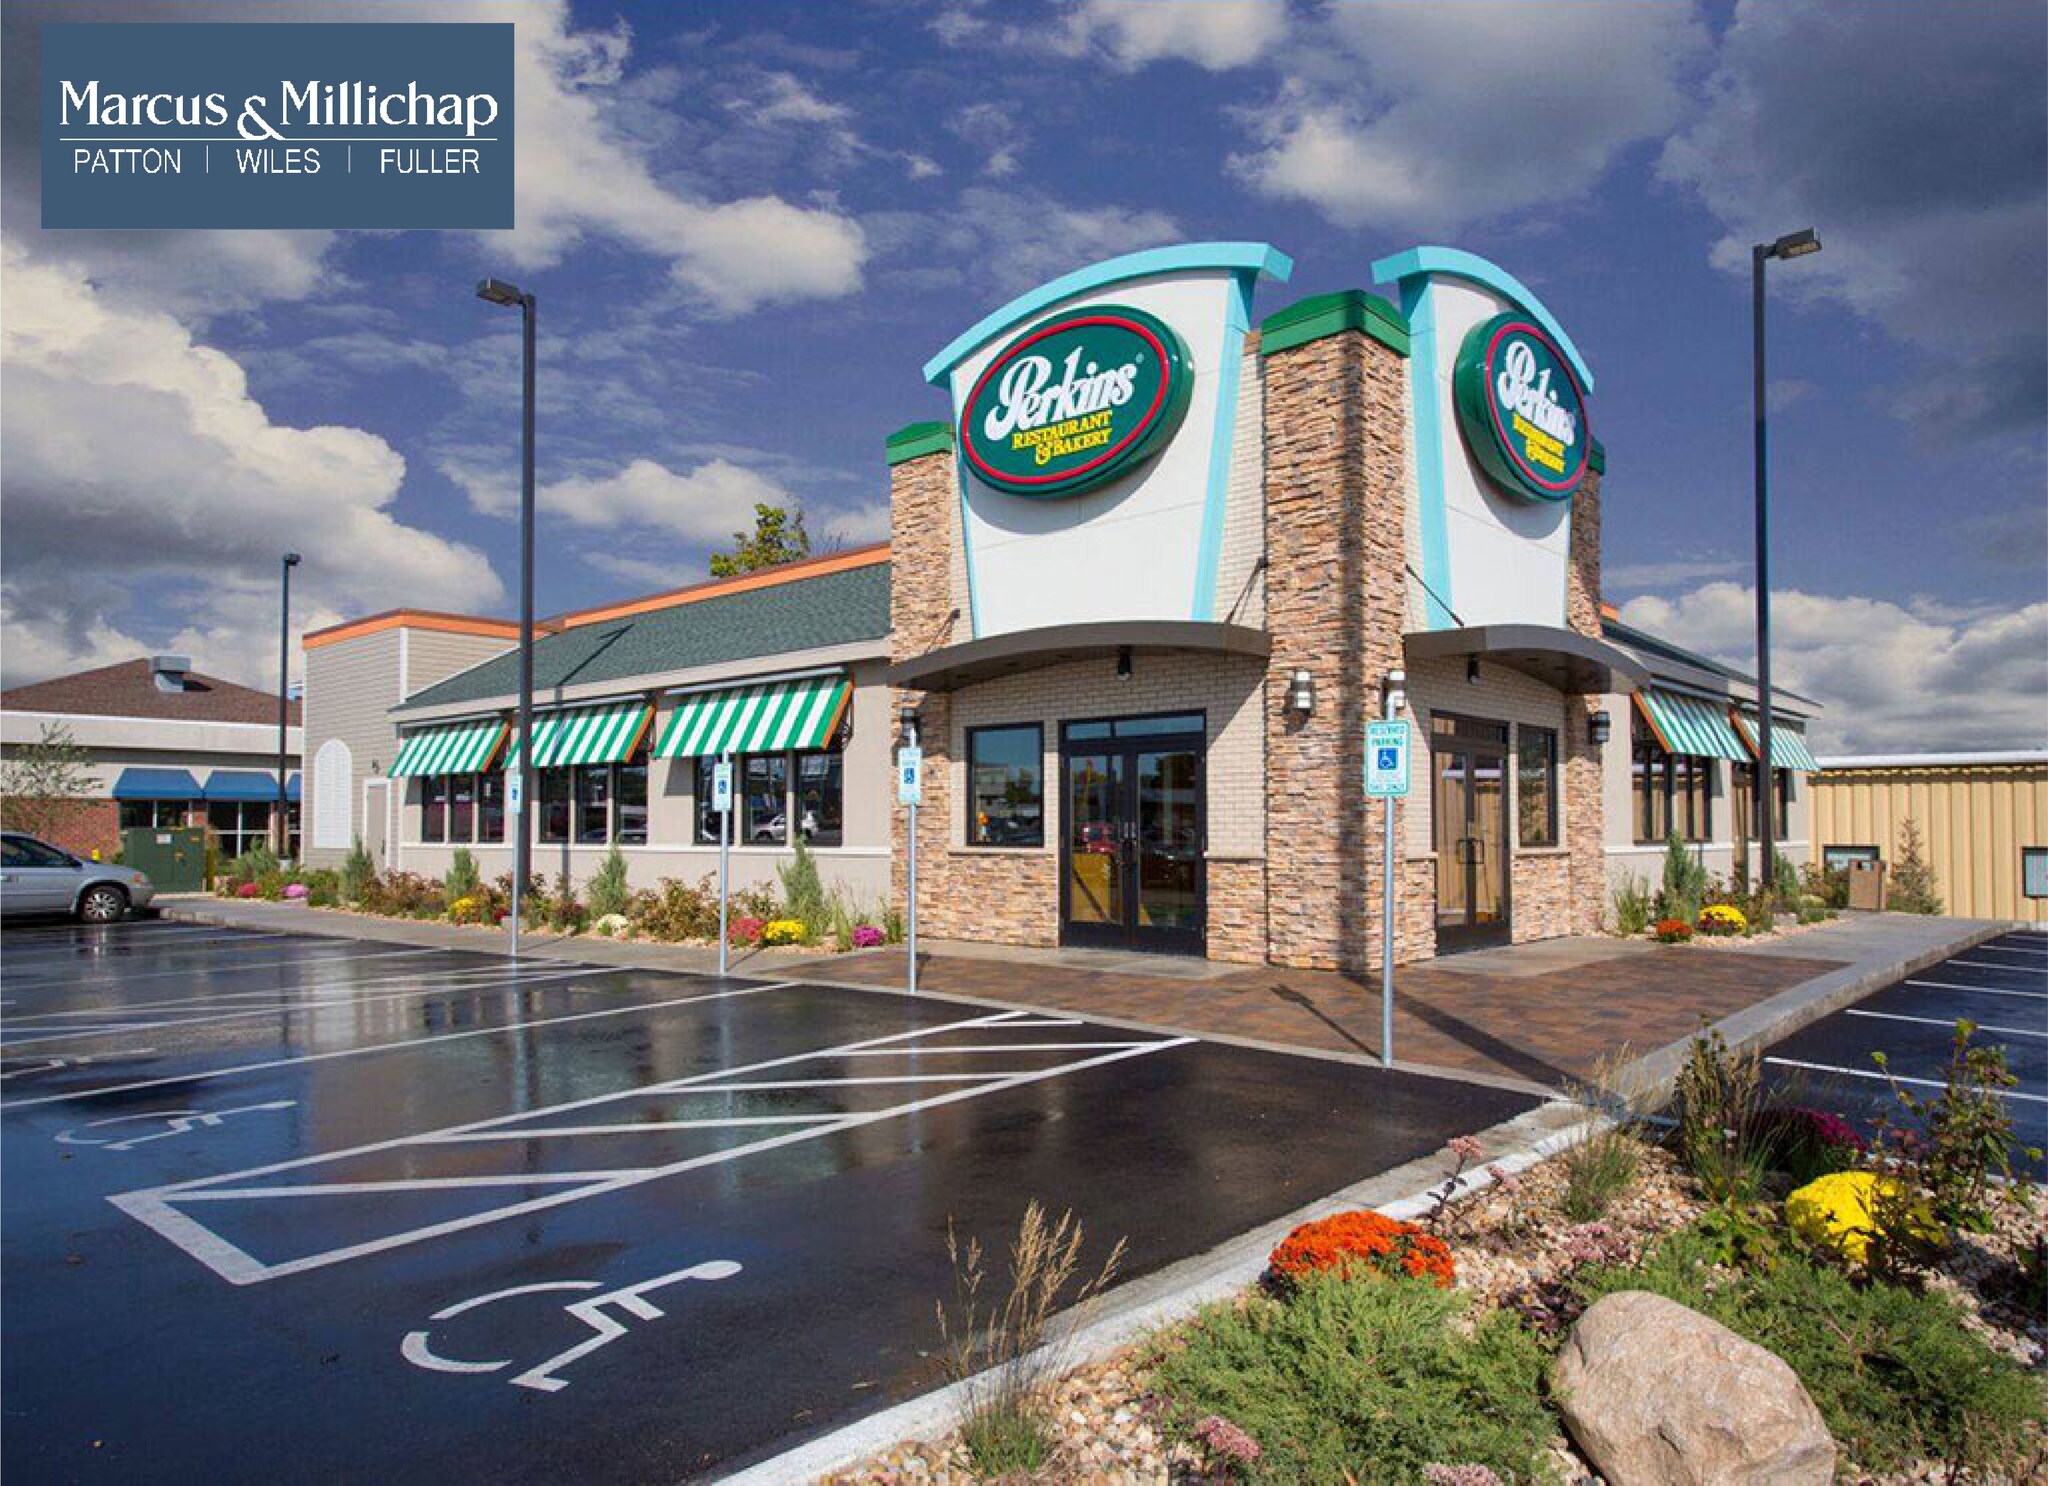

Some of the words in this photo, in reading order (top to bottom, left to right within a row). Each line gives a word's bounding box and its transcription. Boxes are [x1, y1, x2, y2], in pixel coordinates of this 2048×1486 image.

[984, 345, 1137, 441] Perkins
[1498, 340, 1576, 446] Perkins
[1012, 410, 1112, 450] RESTAURANT
[1371, 737, 1404, 747] PARKING
